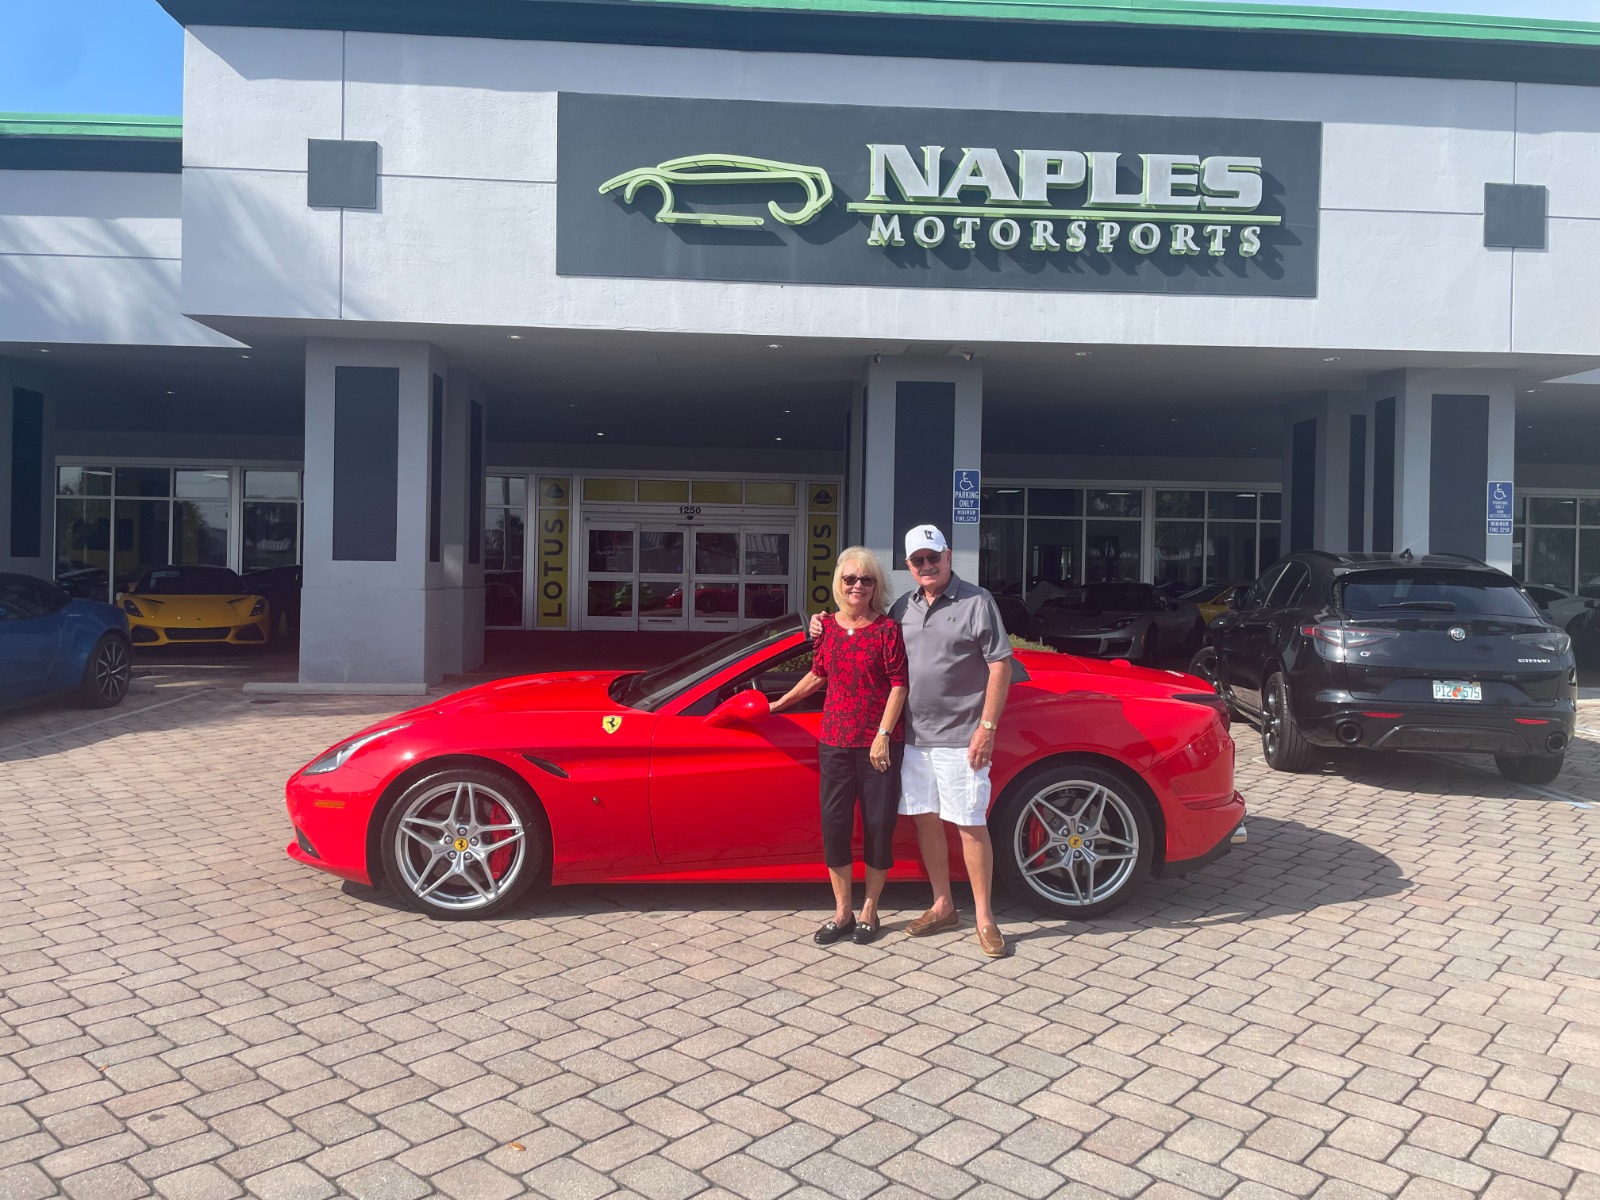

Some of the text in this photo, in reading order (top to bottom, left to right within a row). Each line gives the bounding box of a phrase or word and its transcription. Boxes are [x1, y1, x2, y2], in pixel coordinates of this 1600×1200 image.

[865, 144, 1263, 212] NAPLES
[867, 214, 1261, 257] MOTORSPORTS
[679, 506, 701, 514] 1250
[955, 491, 979, 499] PARKING
[959, 499, 974, 507] ONLY
[543, 519, 564, 617] LOTUS
[812, 524, 832, 615] OTUS
